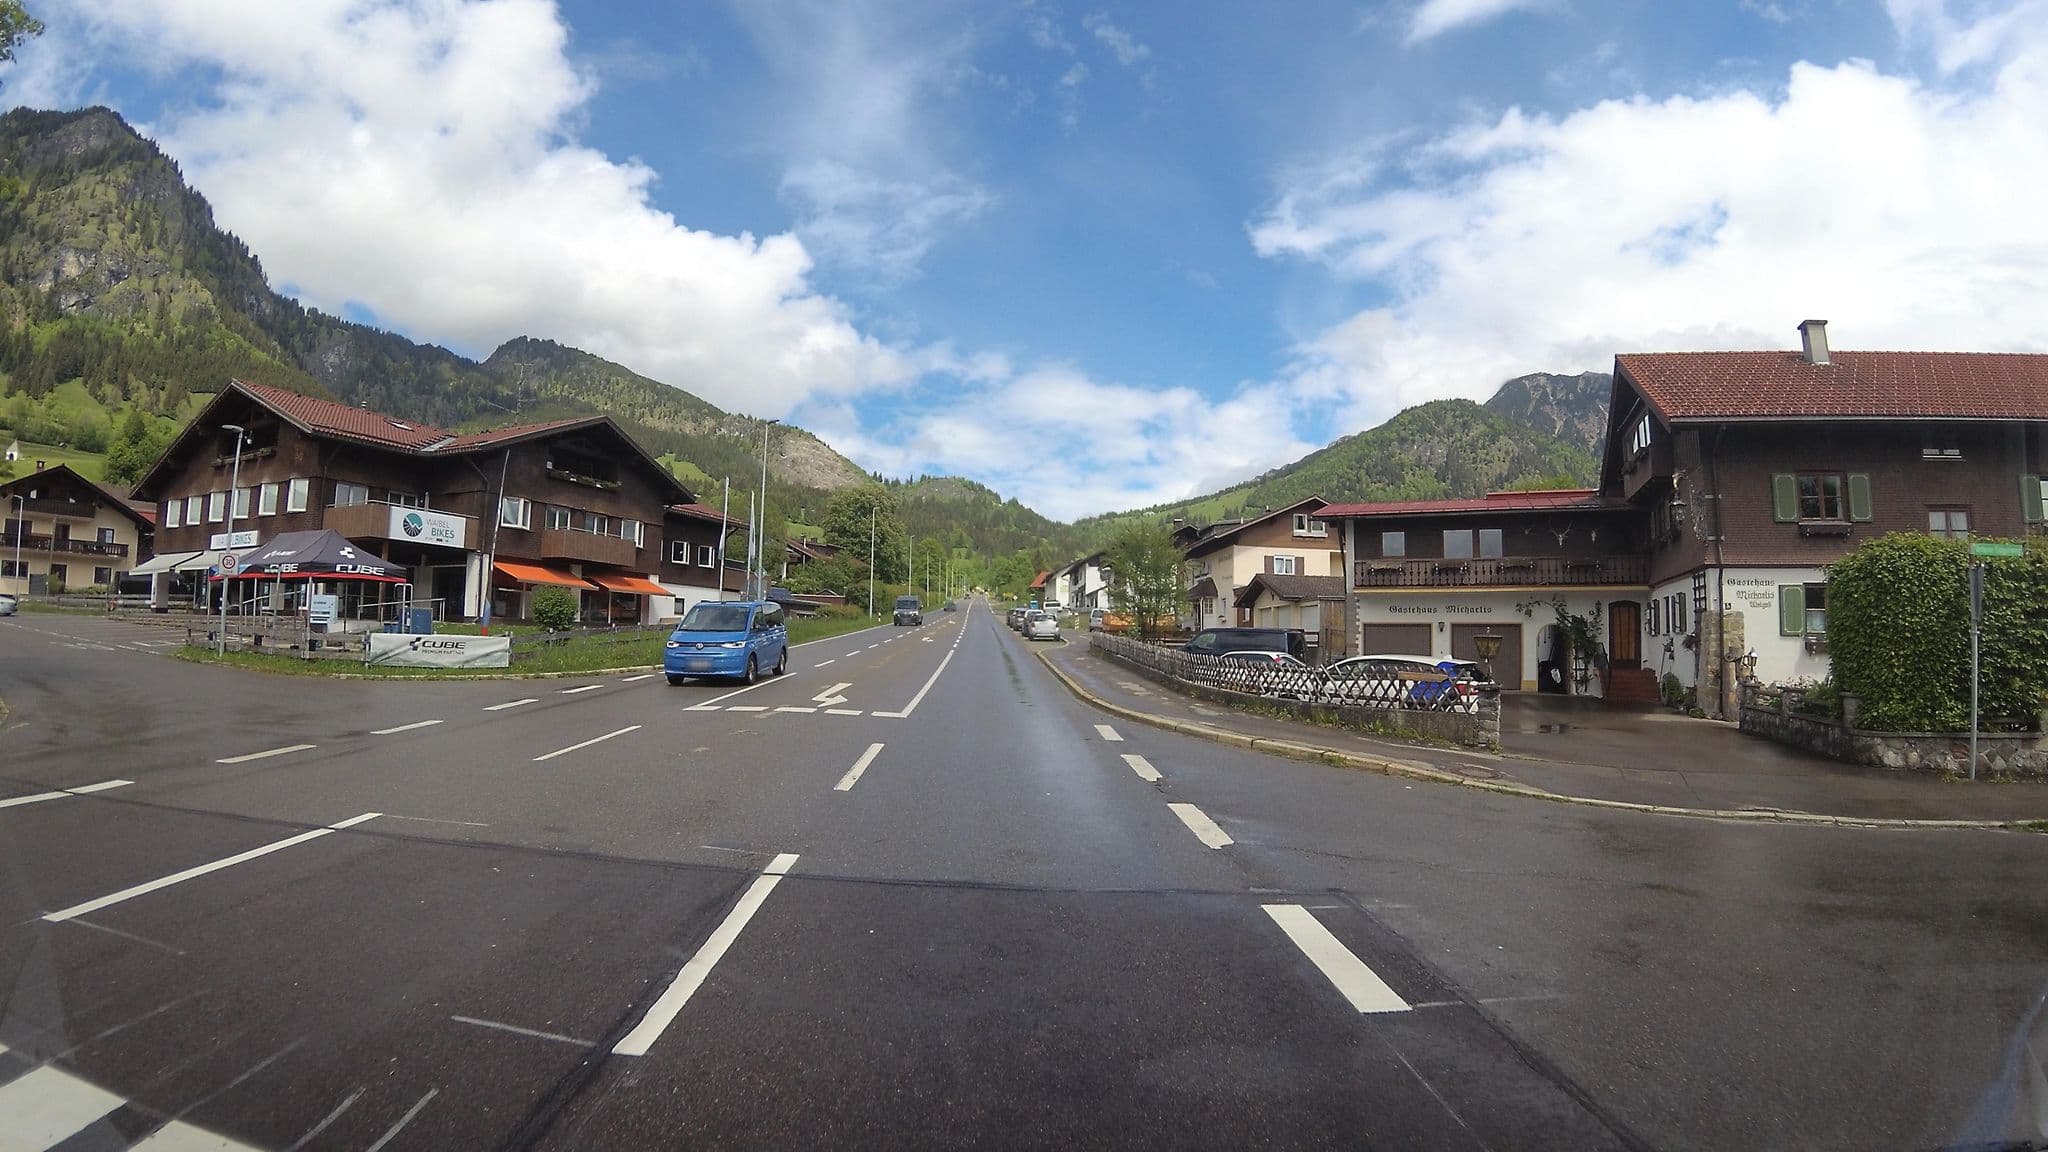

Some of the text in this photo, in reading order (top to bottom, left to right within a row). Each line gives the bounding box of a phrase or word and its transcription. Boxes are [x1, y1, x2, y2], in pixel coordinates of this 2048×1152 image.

[426, 519, 450, 529] WAIBEL
[431, 528, 455, 539] BIKES
[335, 564, 385, 576] CUBE
[422, 640, 467, 649] CUBE
